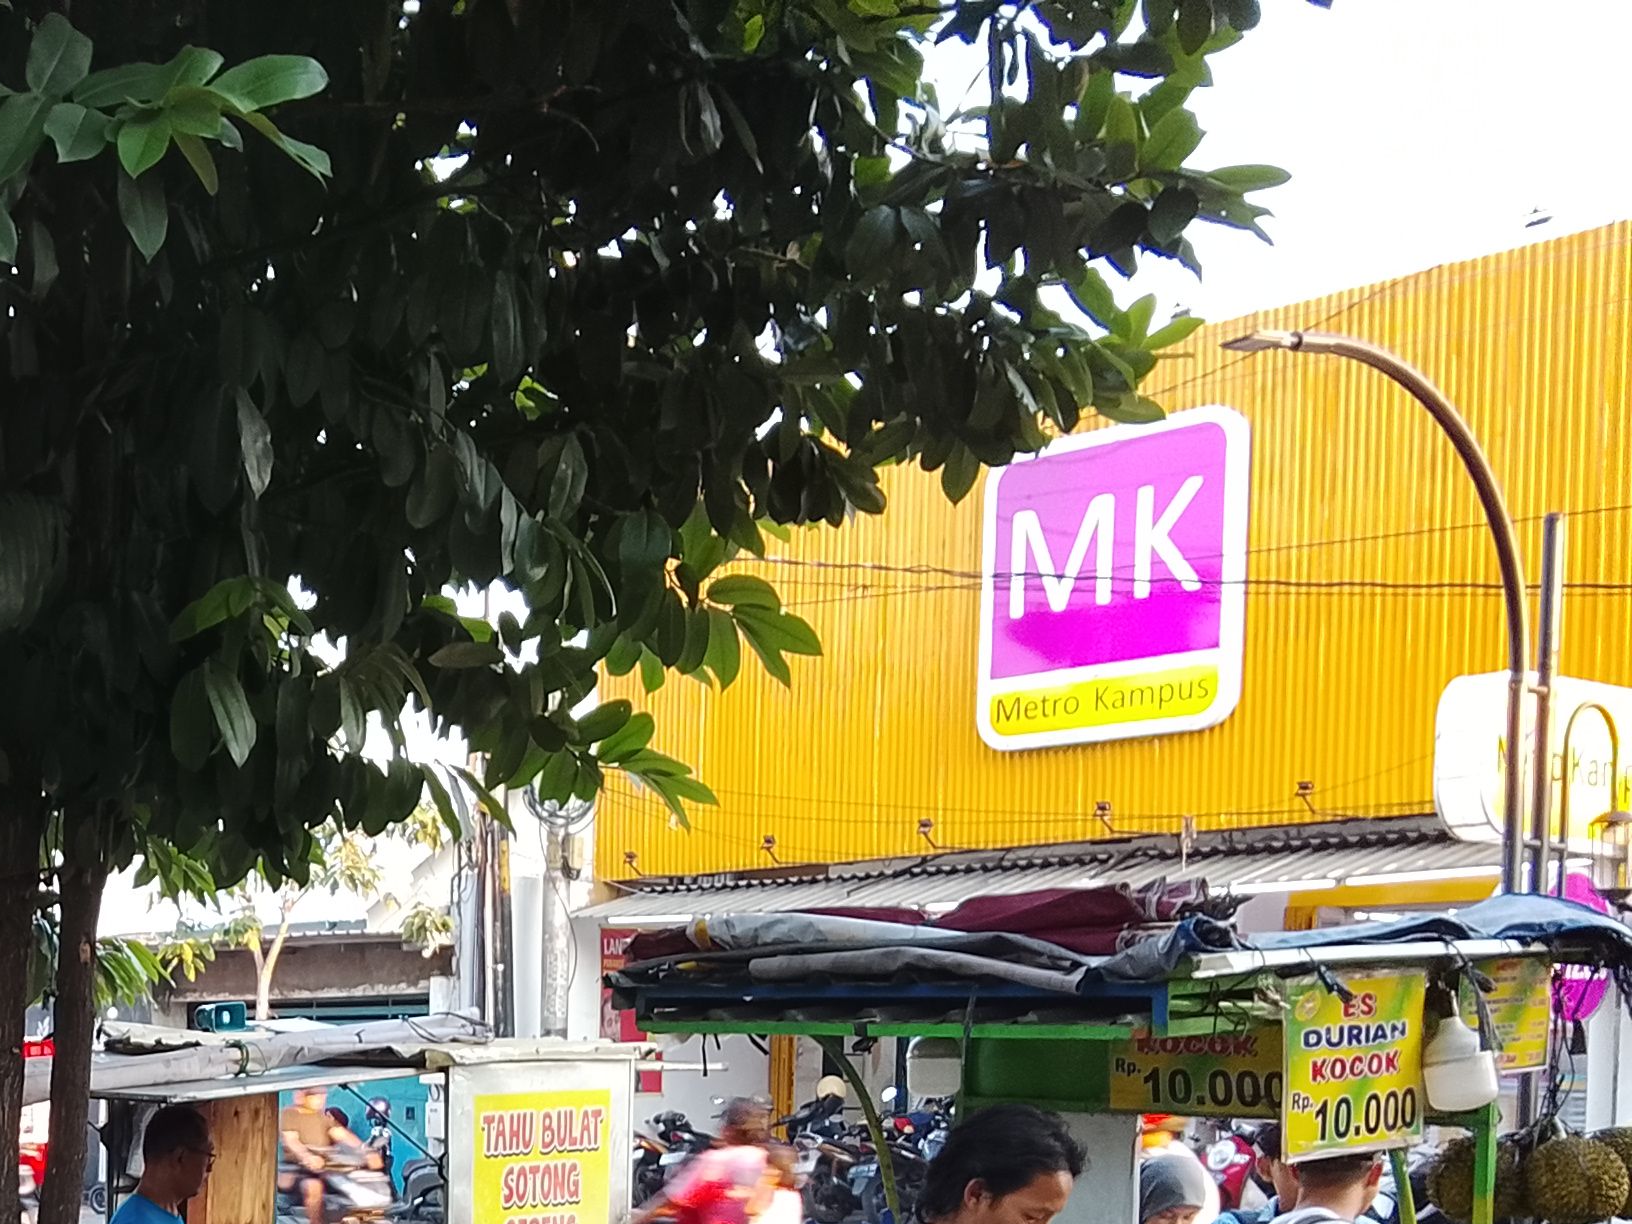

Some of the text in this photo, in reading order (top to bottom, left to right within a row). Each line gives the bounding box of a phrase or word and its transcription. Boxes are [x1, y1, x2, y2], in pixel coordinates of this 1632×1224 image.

[1008, 474, 1205, 620] MK
[995, 677, 1210, 724] Metro Kampus
[1342, 991, 1376, 1019] ES
[1302, 1020, 1407, 1049] DURIAN
[1114, 1056, 1141, 1076] Rp.
[1310, 1049, 1401, 1083] KOCOK
[481, 1107, 604, 1155] TAHU BULAT
[1291, 1086, 1418, 1142] Rp. 10.000
[502, 1161, 581, 1206] SOTONG
